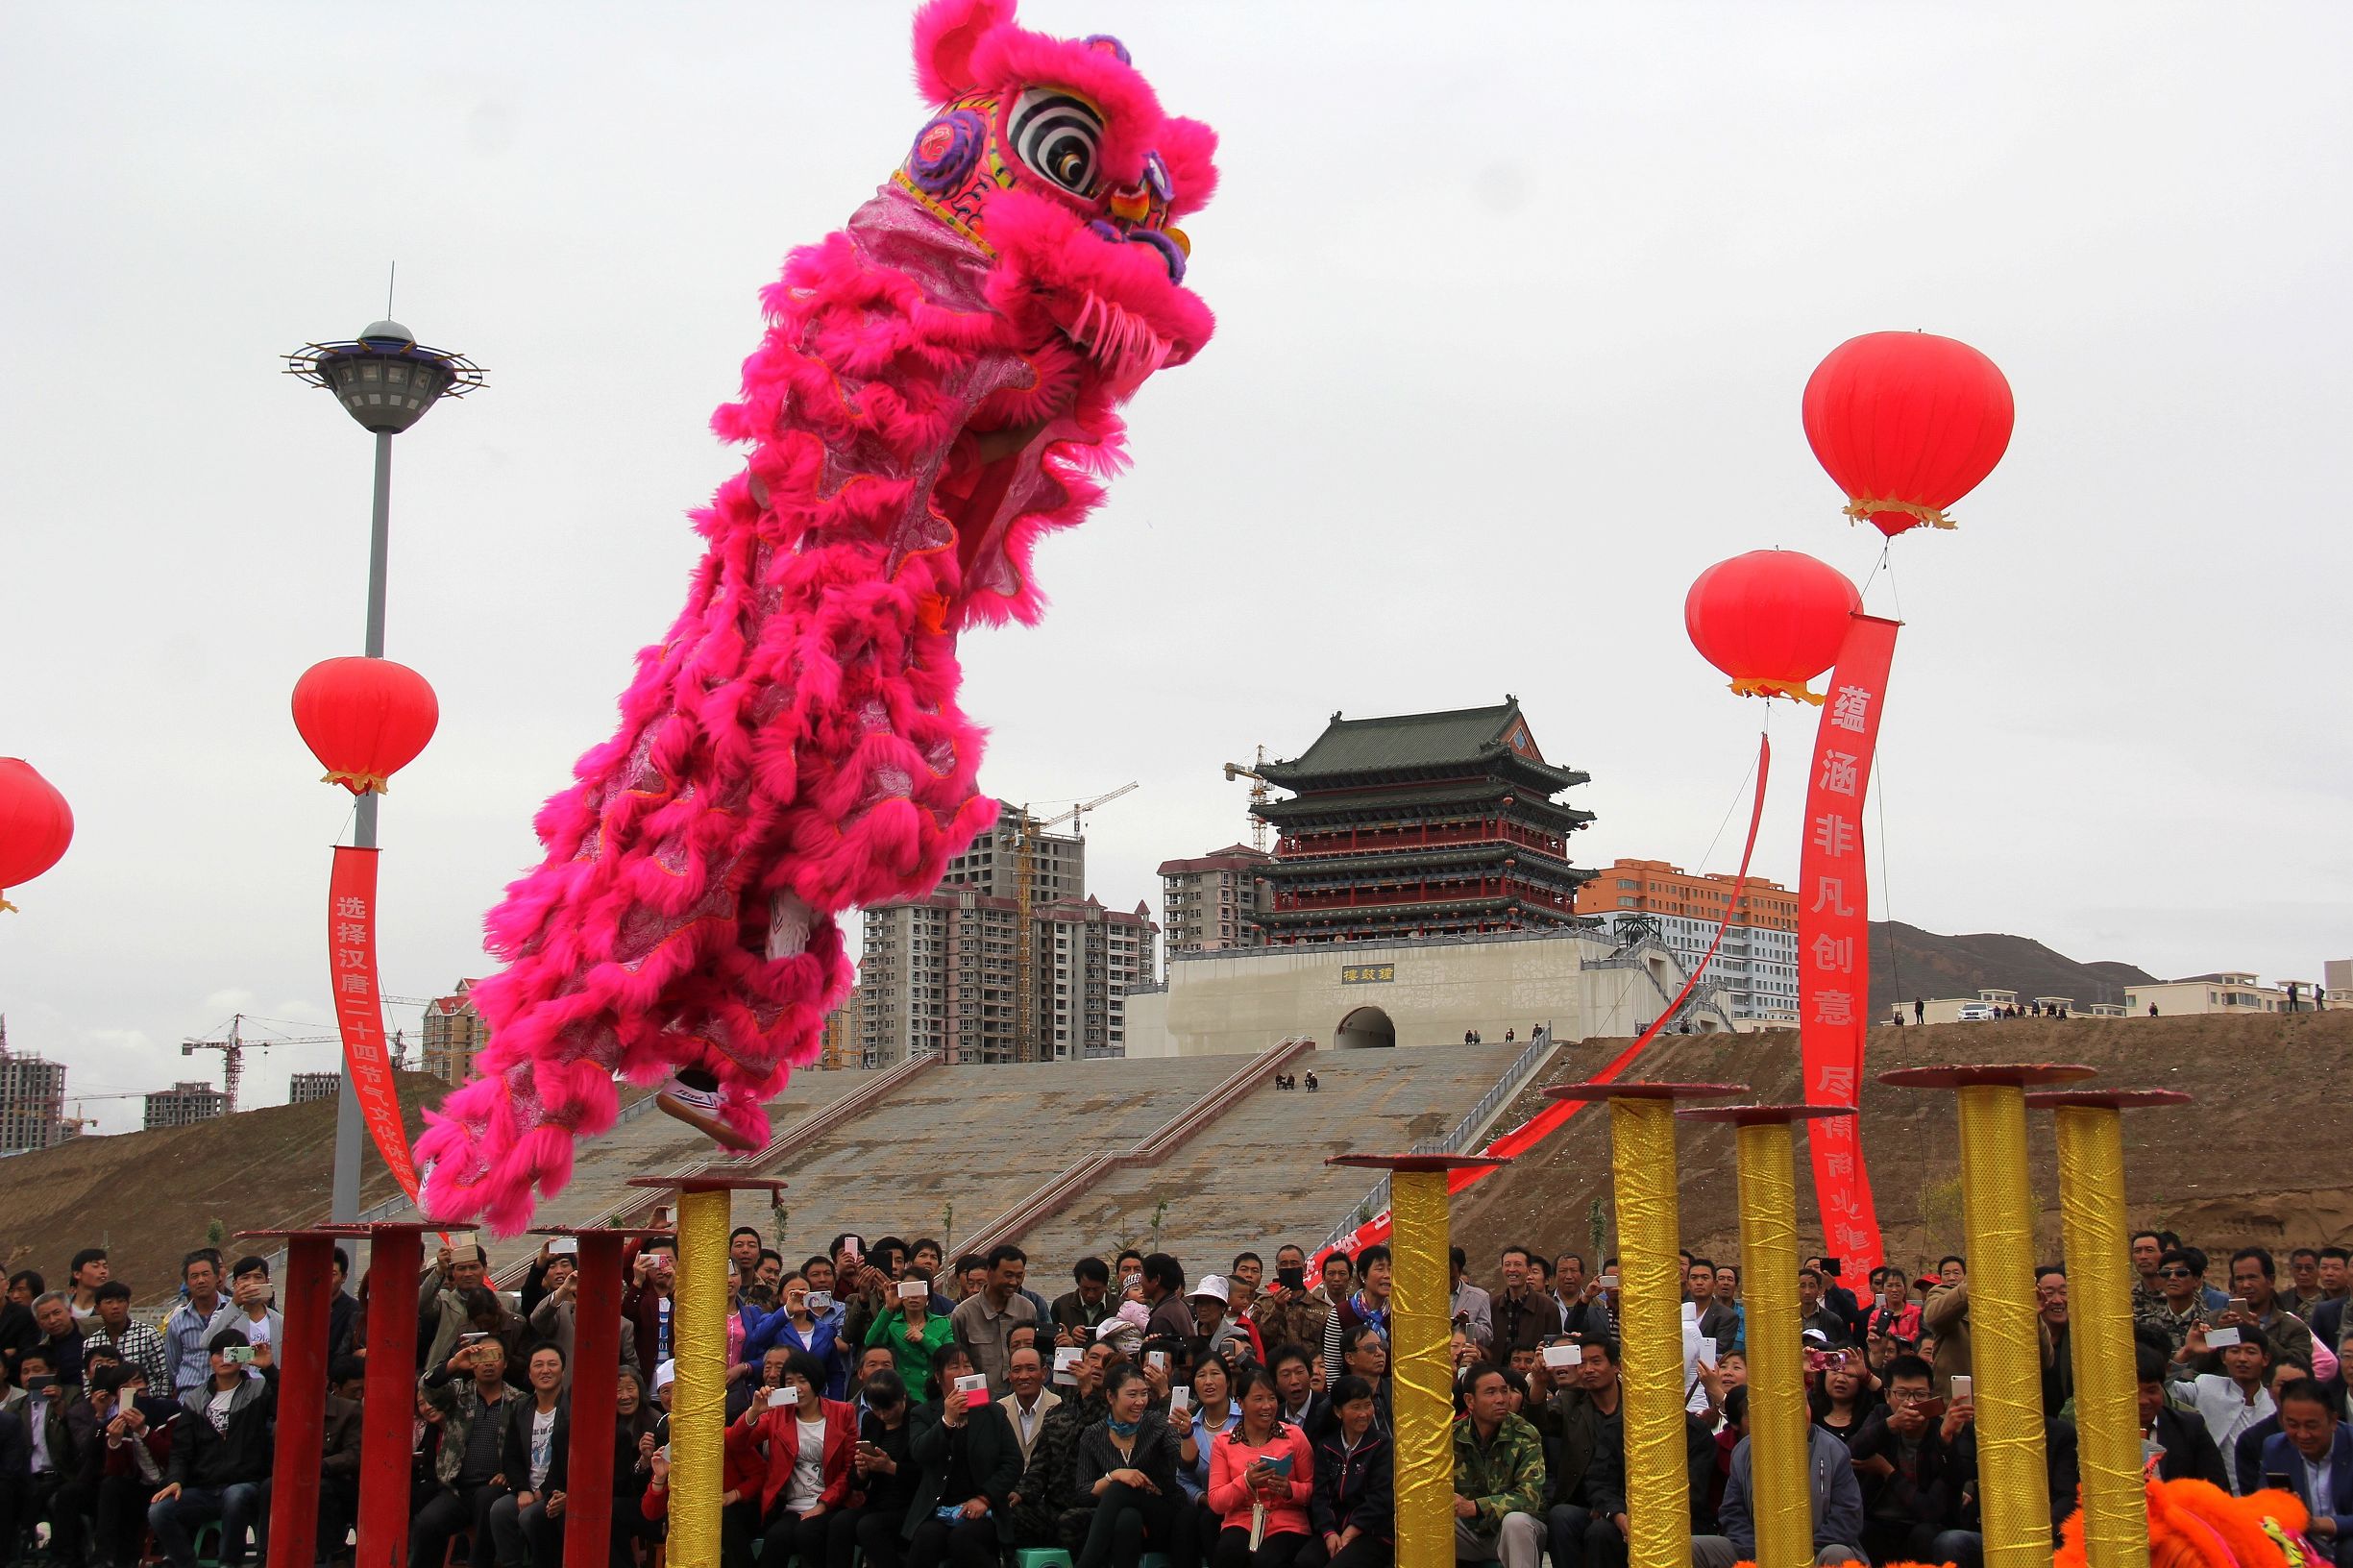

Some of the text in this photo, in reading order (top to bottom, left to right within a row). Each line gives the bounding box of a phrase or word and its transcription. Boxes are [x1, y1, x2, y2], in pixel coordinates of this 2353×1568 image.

[1810, 685, 1872, 1026] 蕴涵非凡创意
